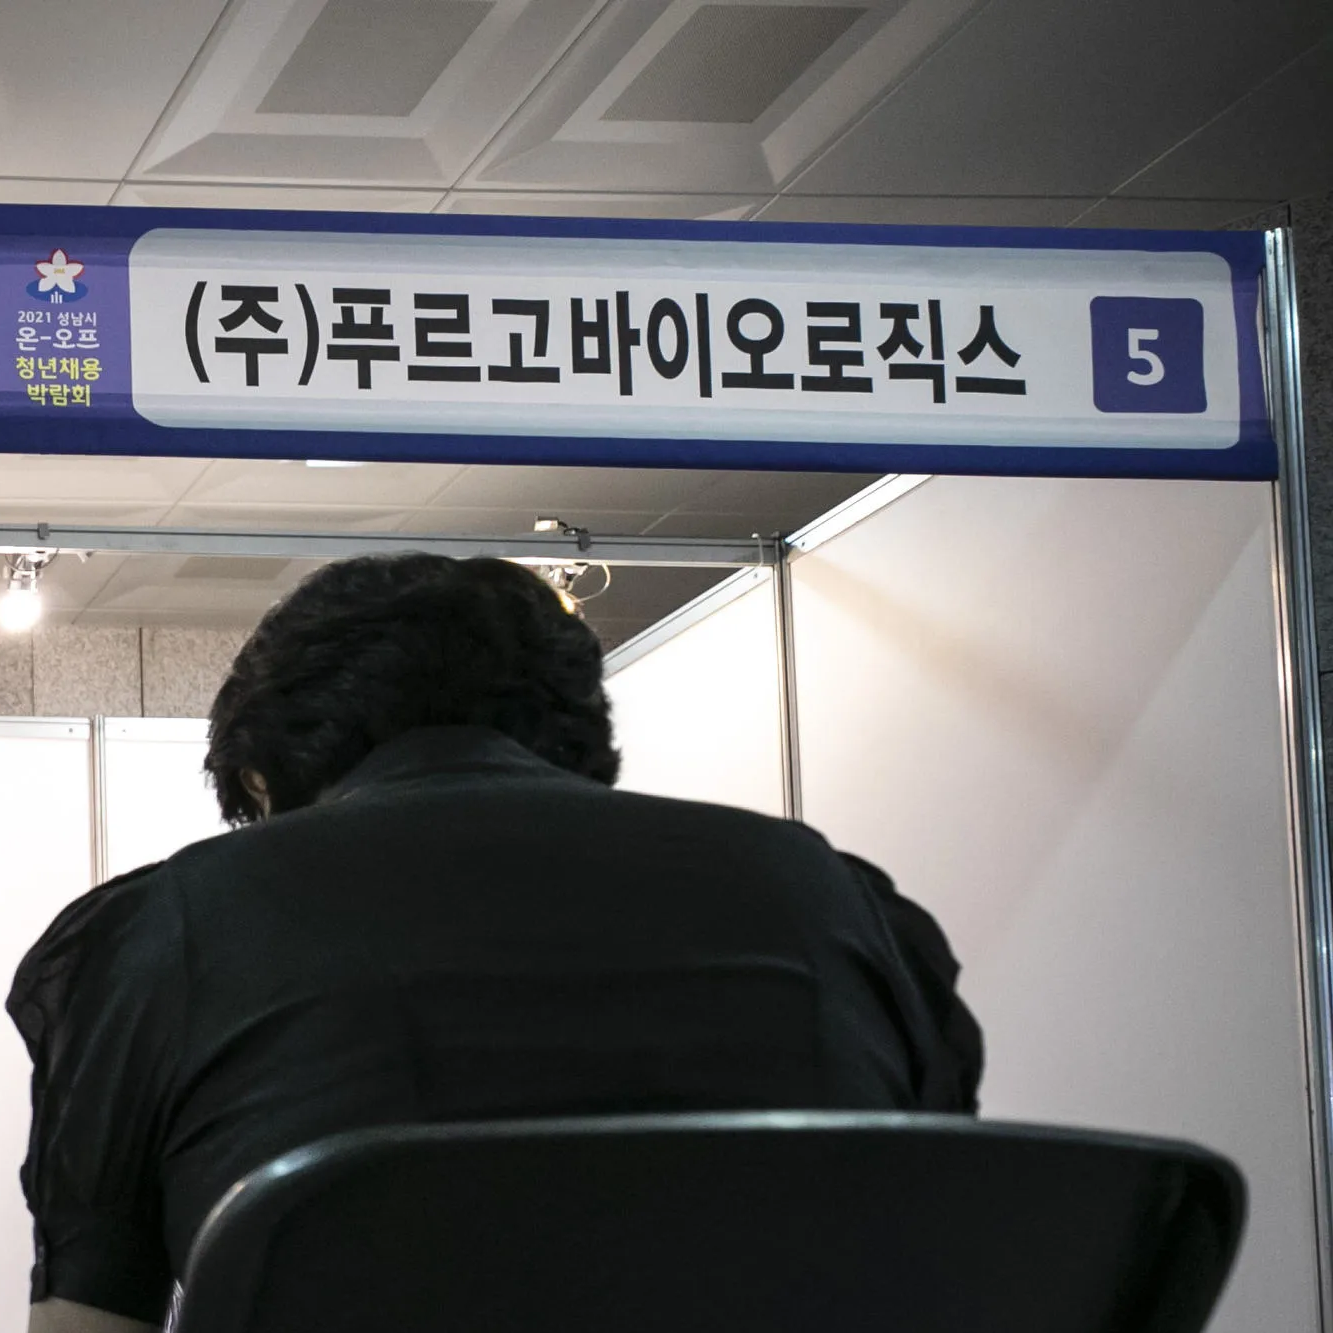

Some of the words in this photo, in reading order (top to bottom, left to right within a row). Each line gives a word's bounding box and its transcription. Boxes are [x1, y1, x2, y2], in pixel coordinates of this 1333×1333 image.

[17, 310, 51, 324] 2021
[57, 312, 97, 327] 성남시
[15, 326, 100, 352] 온-오프
[184, 280, 1027, 404] (주)푸르고바이오로직스
[15, 355, 103, 381] 청년채용
[1126, 327, 1165, 386] 5
[26, 383, 91, 407] 박람회
